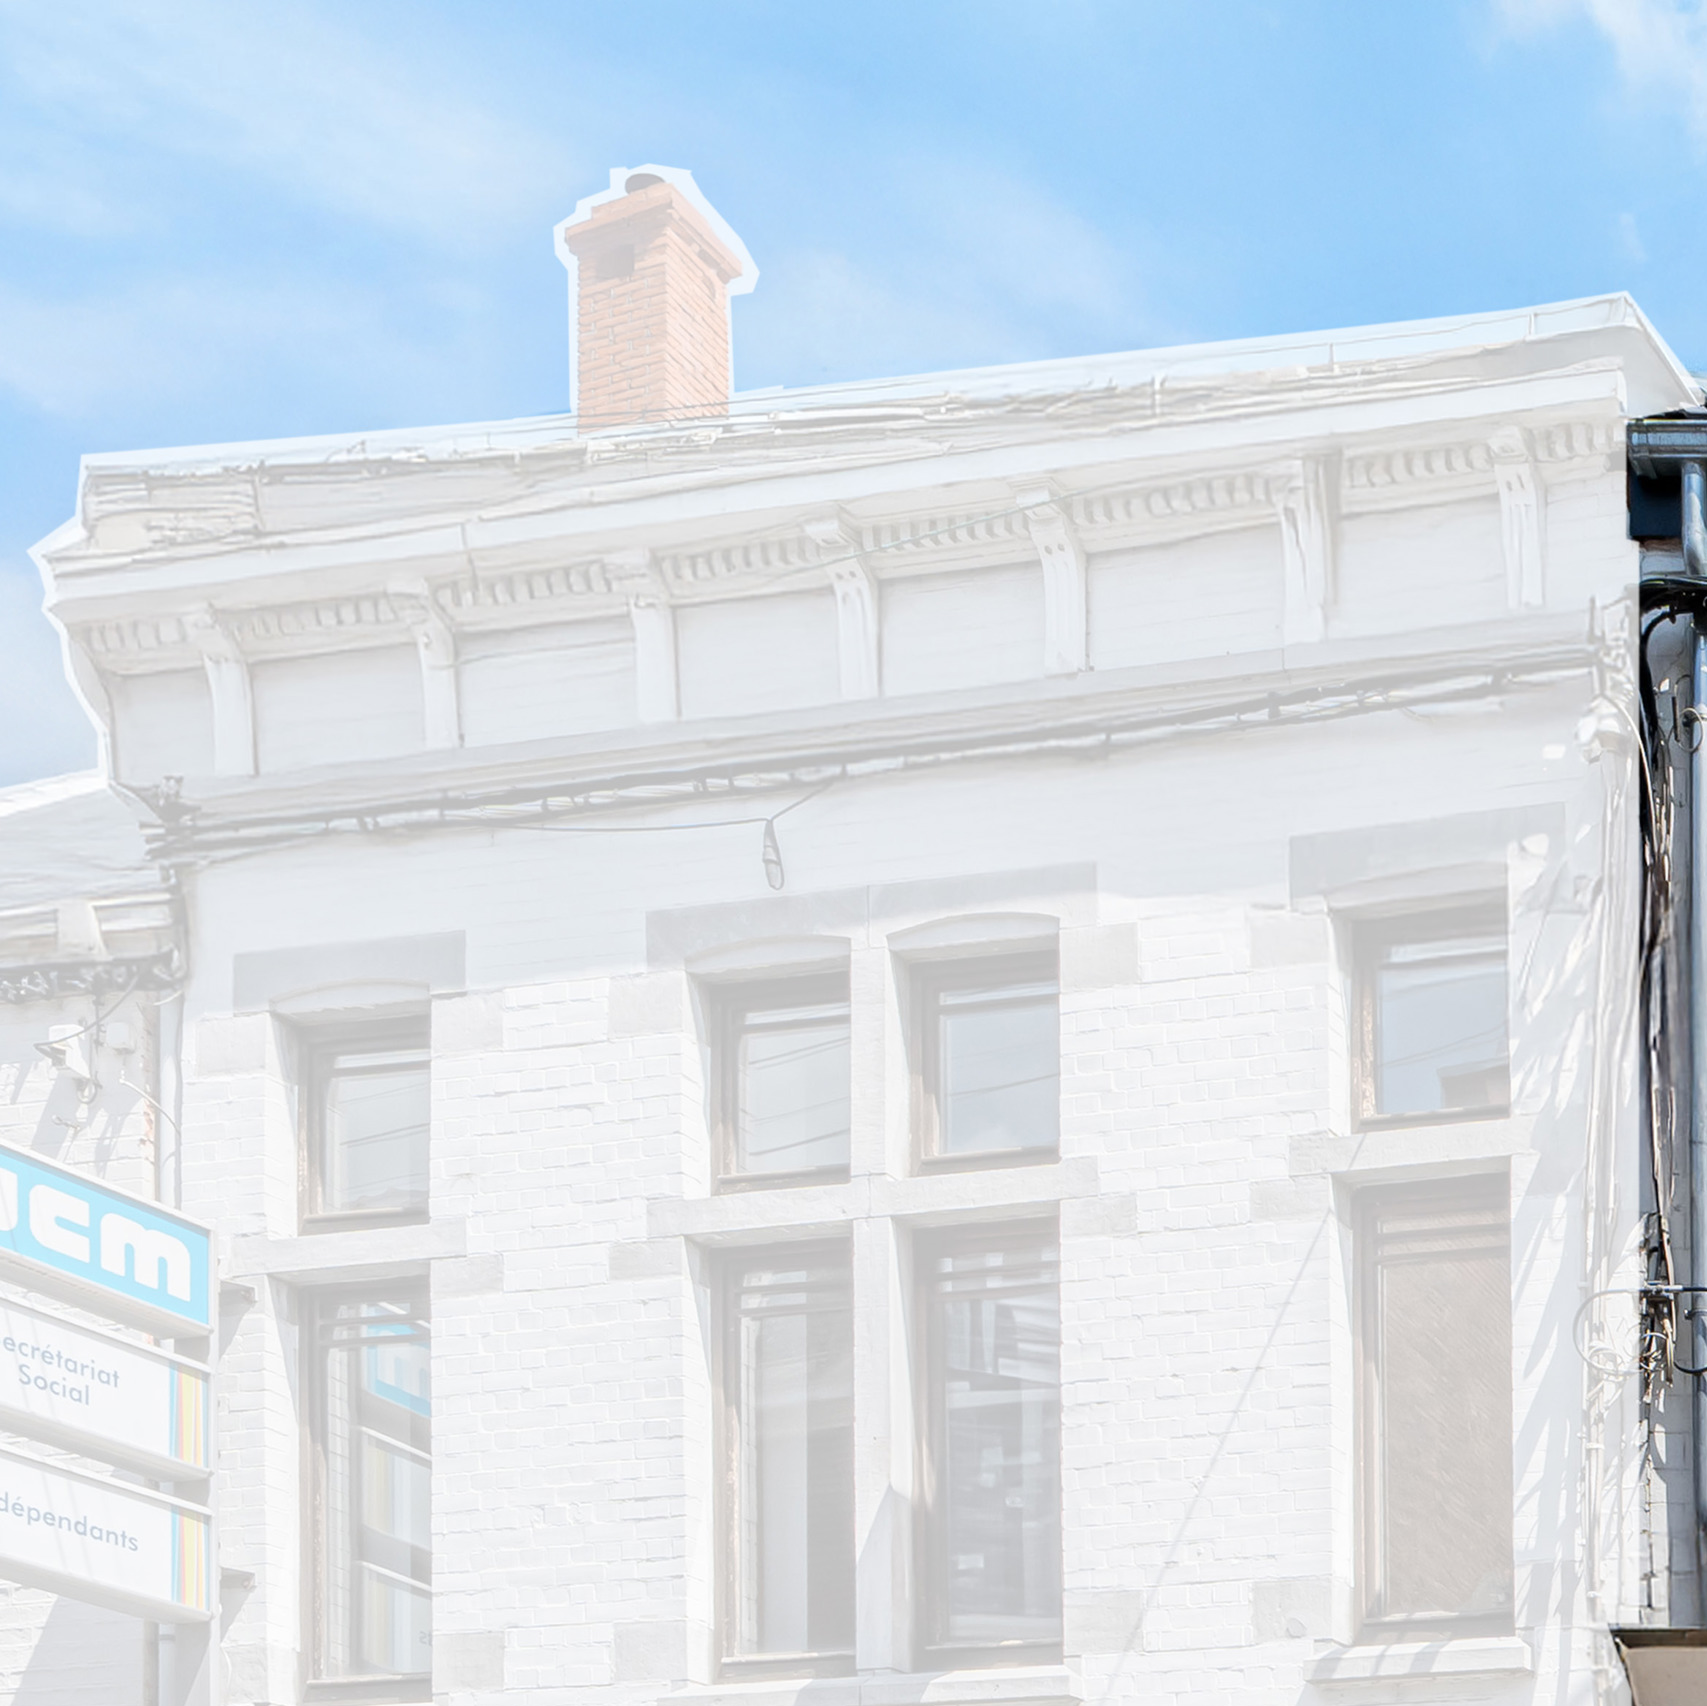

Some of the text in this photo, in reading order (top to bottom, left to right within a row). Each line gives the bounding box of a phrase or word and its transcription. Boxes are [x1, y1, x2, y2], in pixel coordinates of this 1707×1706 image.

[0, 1166, 191, 1302] cm
[0, 1335, 120, 1388] ecrétariat
[18, 1363, 90, 1406] Social
